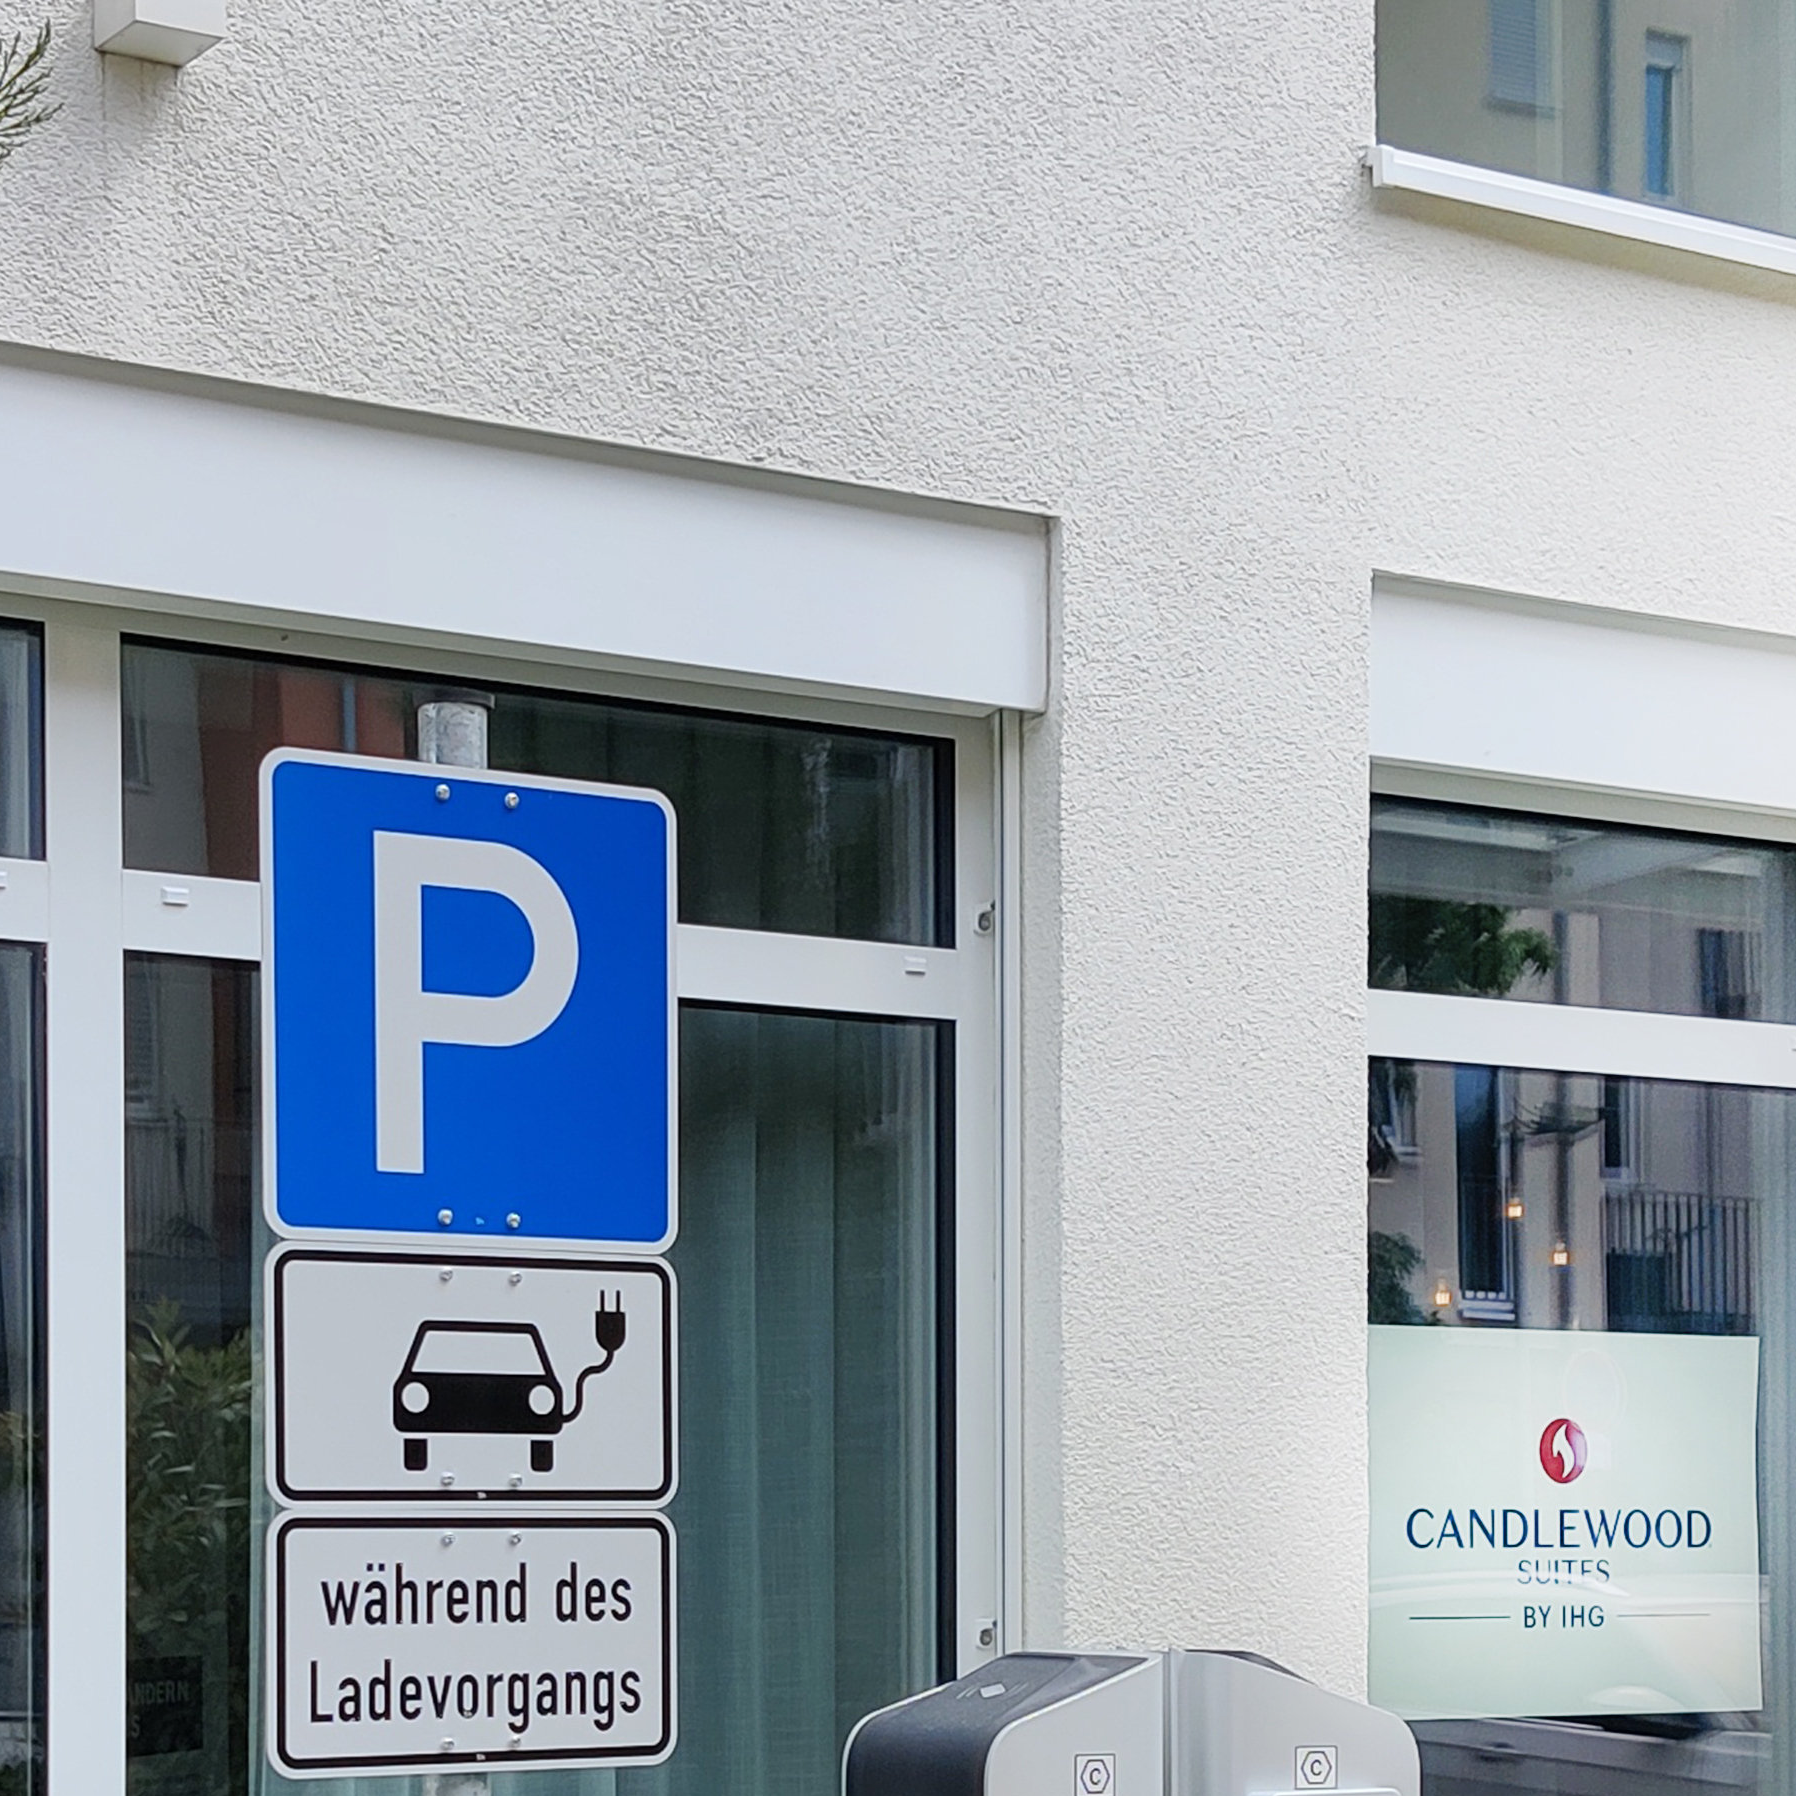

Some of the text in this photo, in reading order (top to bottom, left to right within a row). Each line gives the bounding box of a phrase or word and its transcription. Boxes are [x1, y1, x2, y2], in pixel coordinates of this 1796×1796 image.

[373, 829, 580, 1174] P
[1406, 1508, 1712, 1549] CANDLEWOOD
[321, 1561, 633, 1626] während des
[1524, 1605, 1605, 1628] BY IHG
[310, 1658, 642, 1734] Ladevorgangs
[1089, 1767, 1102, 1786] C
[1310, 1759, 1323, 1776] C
